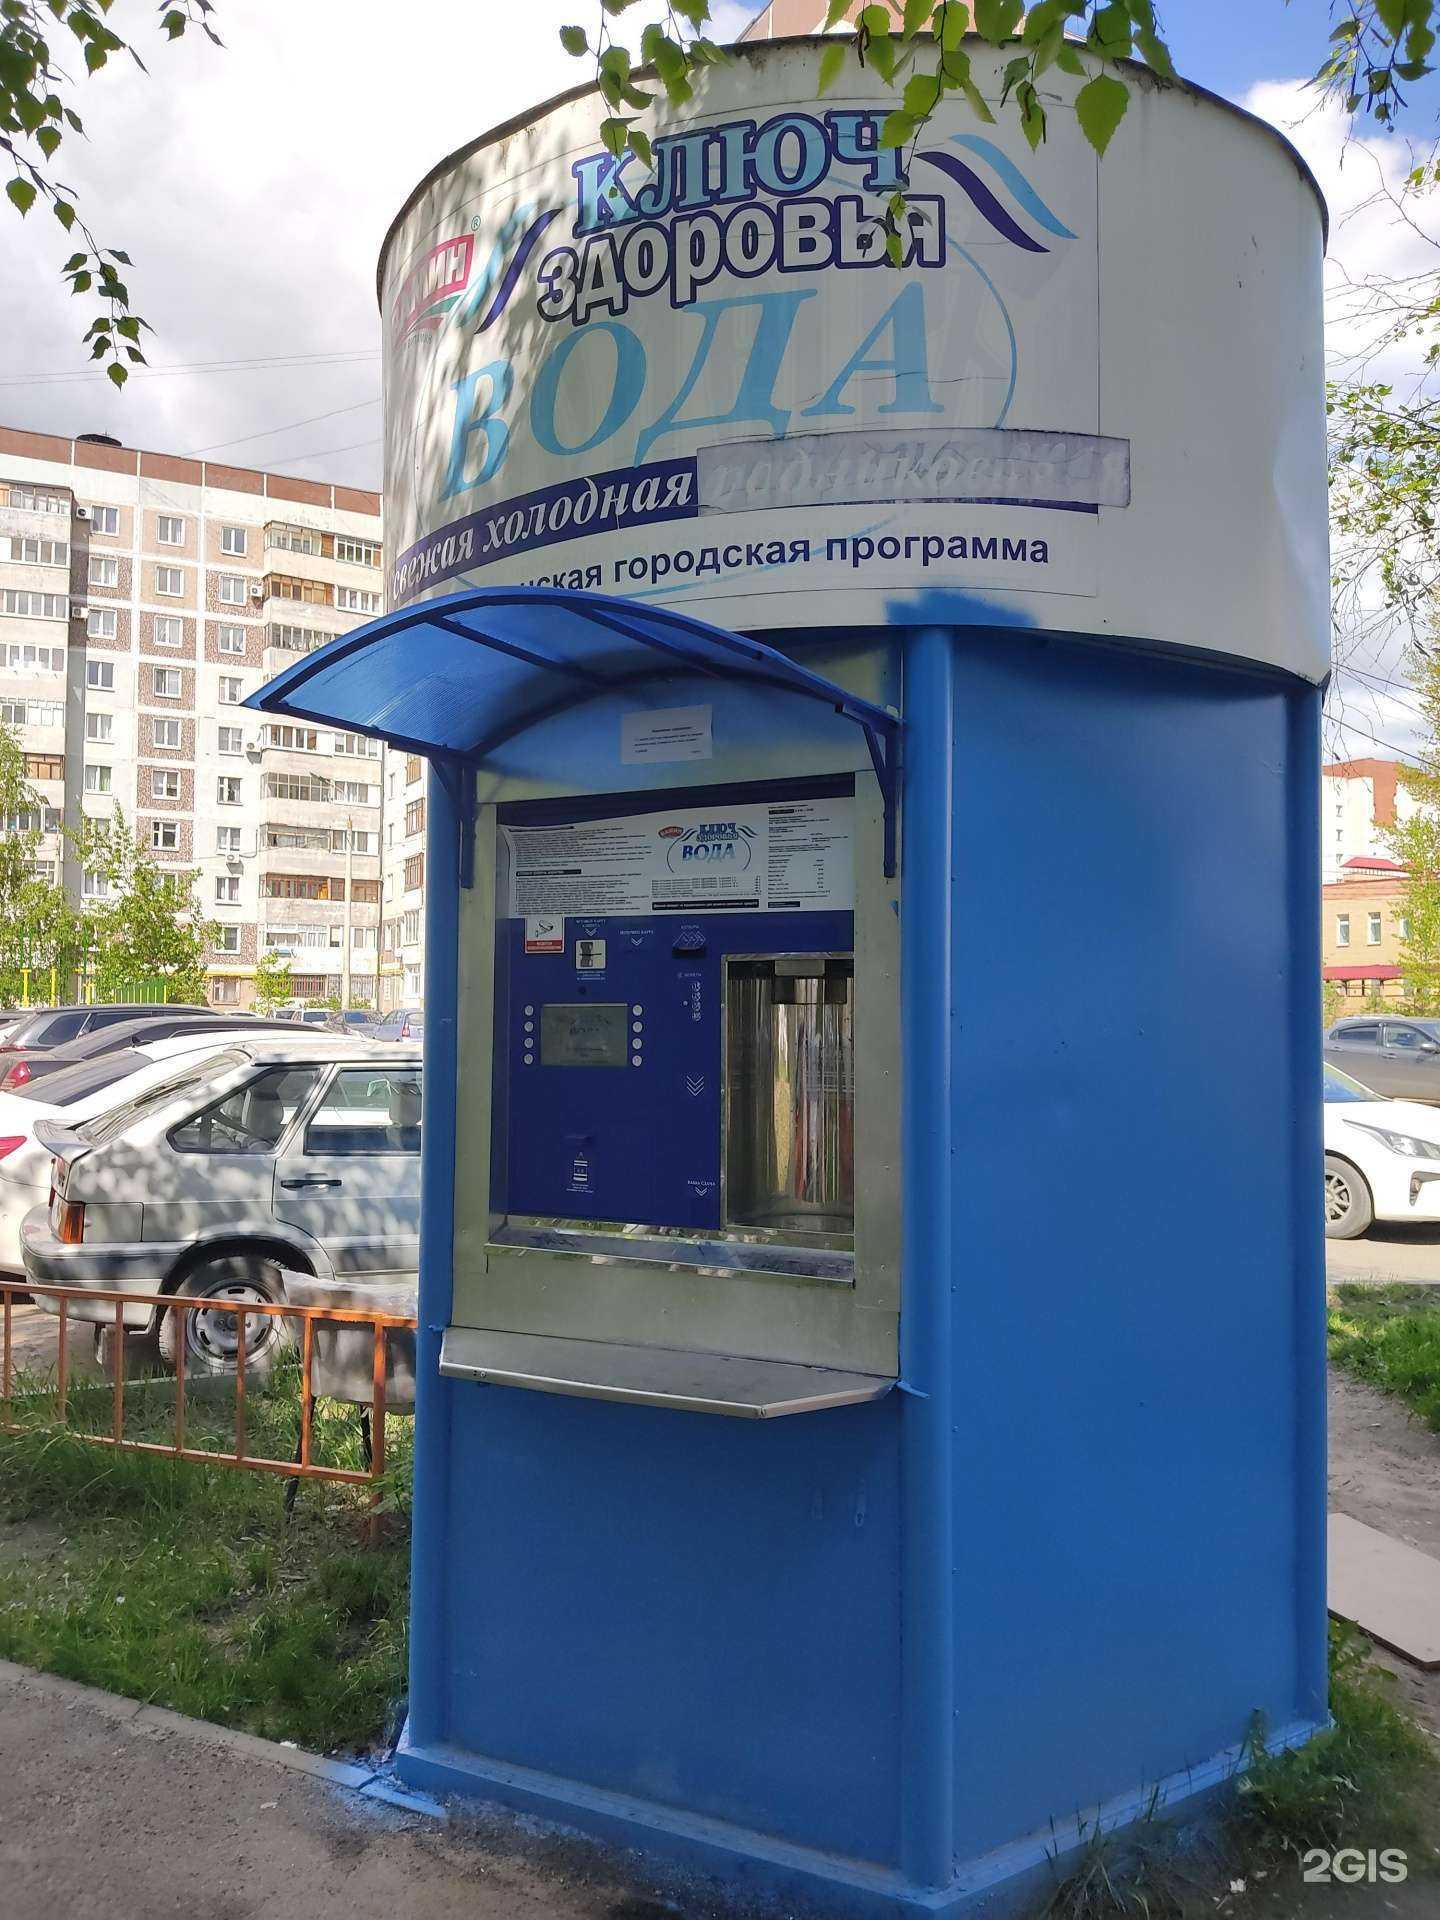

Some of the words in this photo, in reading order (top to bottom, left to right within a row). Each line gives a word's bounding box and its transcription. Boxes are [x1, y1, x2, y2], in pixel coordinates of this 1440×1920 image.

[572, 109, 910, 239] КЛЮЧ
[440, 281, 945, 501] ВОДА
[392, 528, 475, 601] свежая
[481, 472, 693, 553] холодная
[520, 564, 602, 590] ская
[613, 539, 811, 584] городская
[826, 535, 1050, 568] программа
[682, 843, 736, 862] ВОДА
